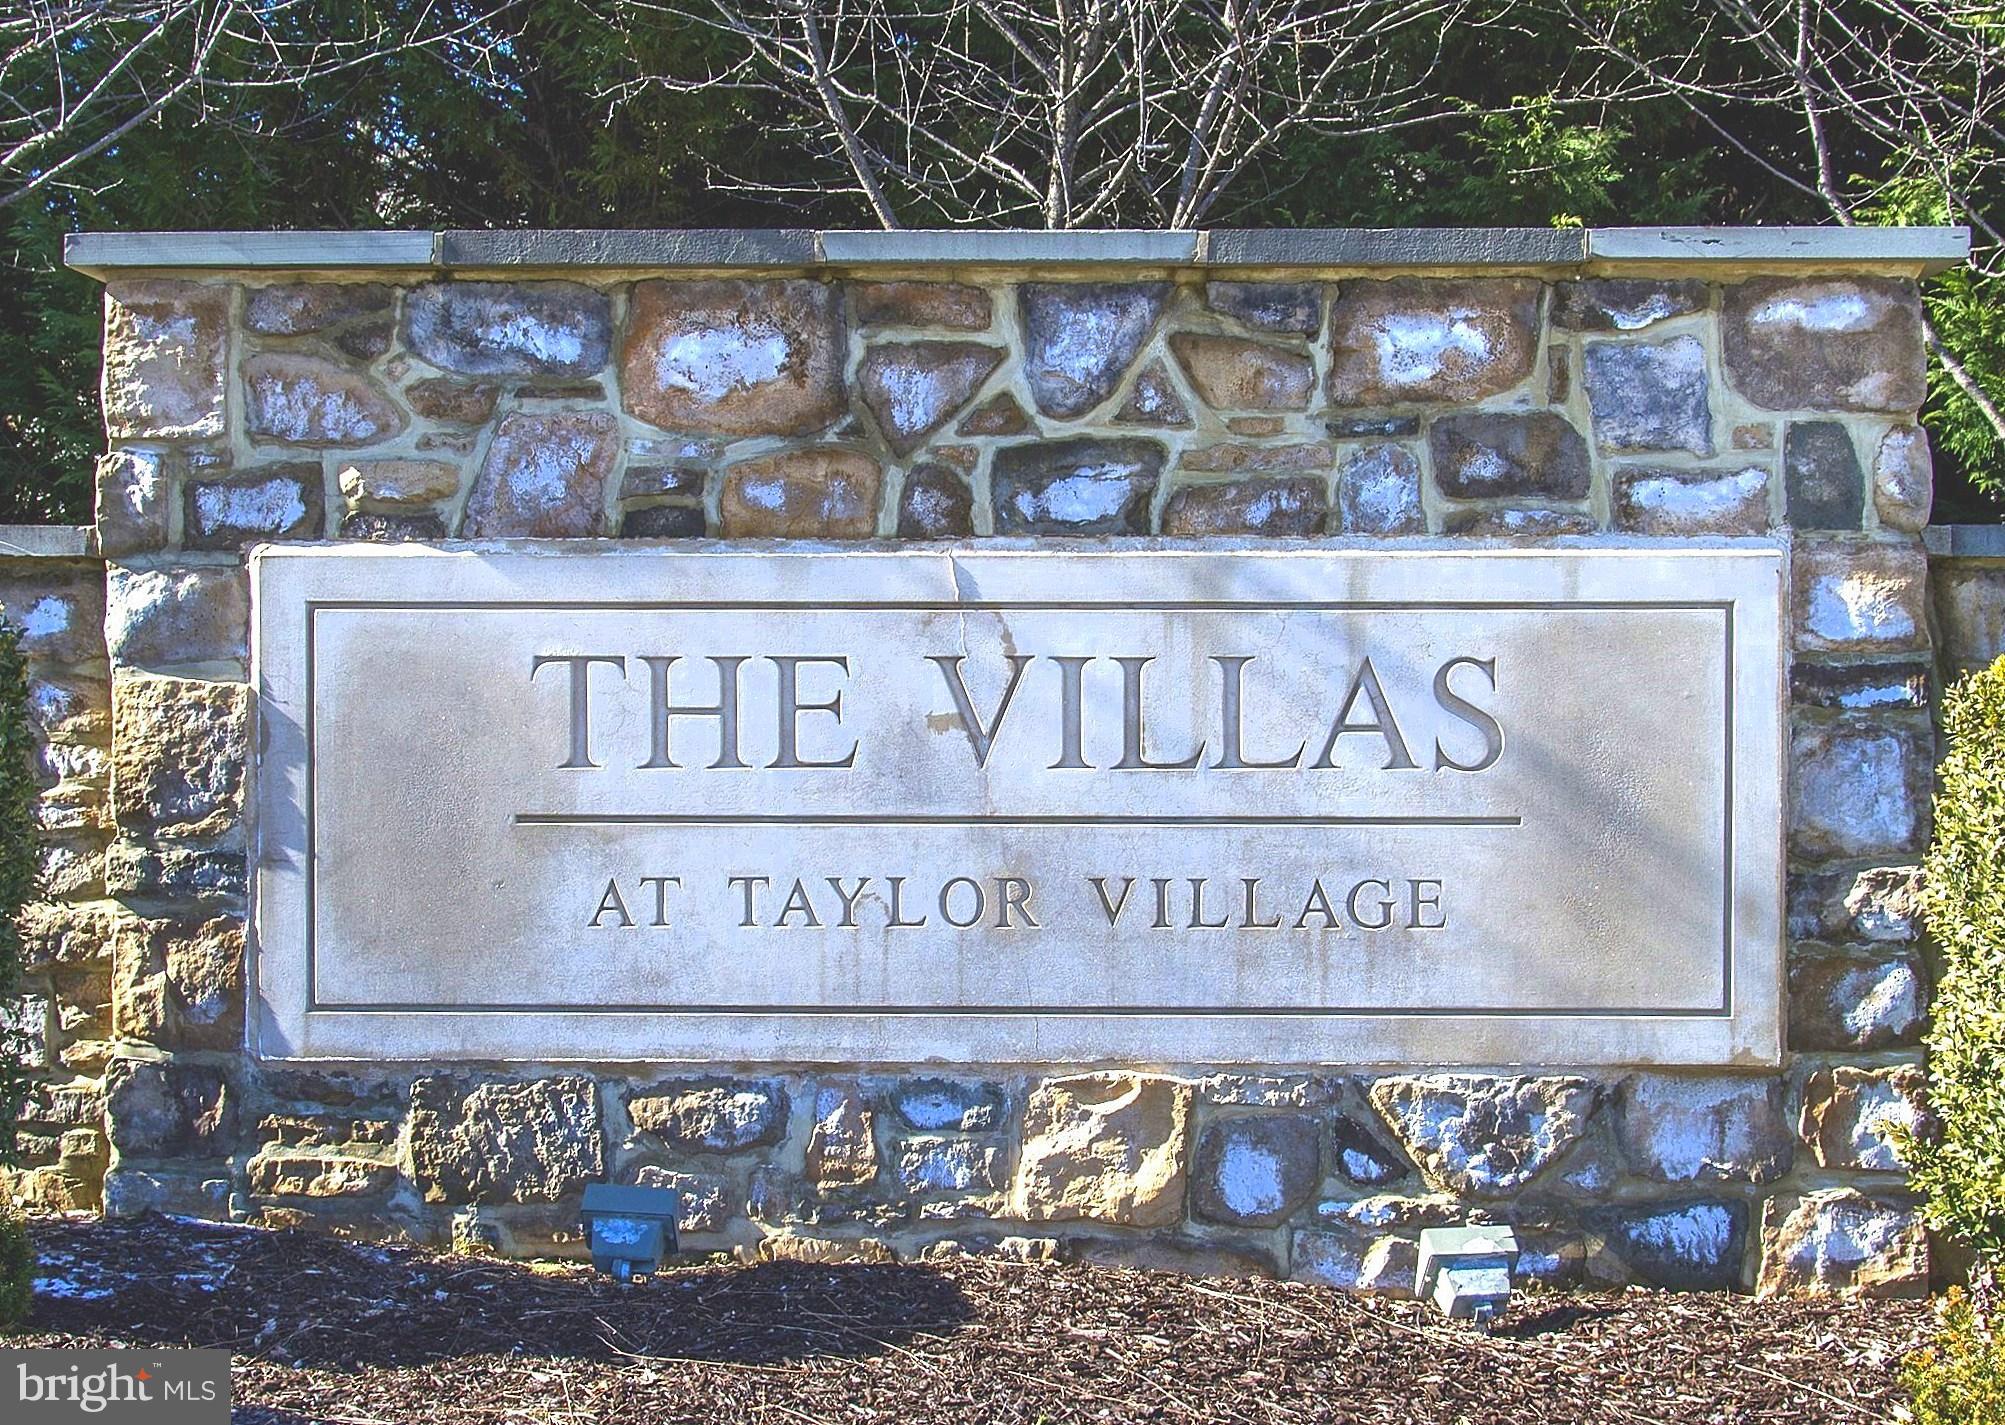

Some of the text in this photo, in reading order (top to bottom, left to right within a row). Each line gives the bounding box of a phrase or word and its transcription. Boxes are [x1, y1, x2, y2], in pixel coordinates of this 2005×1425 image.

[530, 655, 1506, 773] THE VILLAS
[587, 876, 1448, 931] AT TAYLOR VILLAGE
